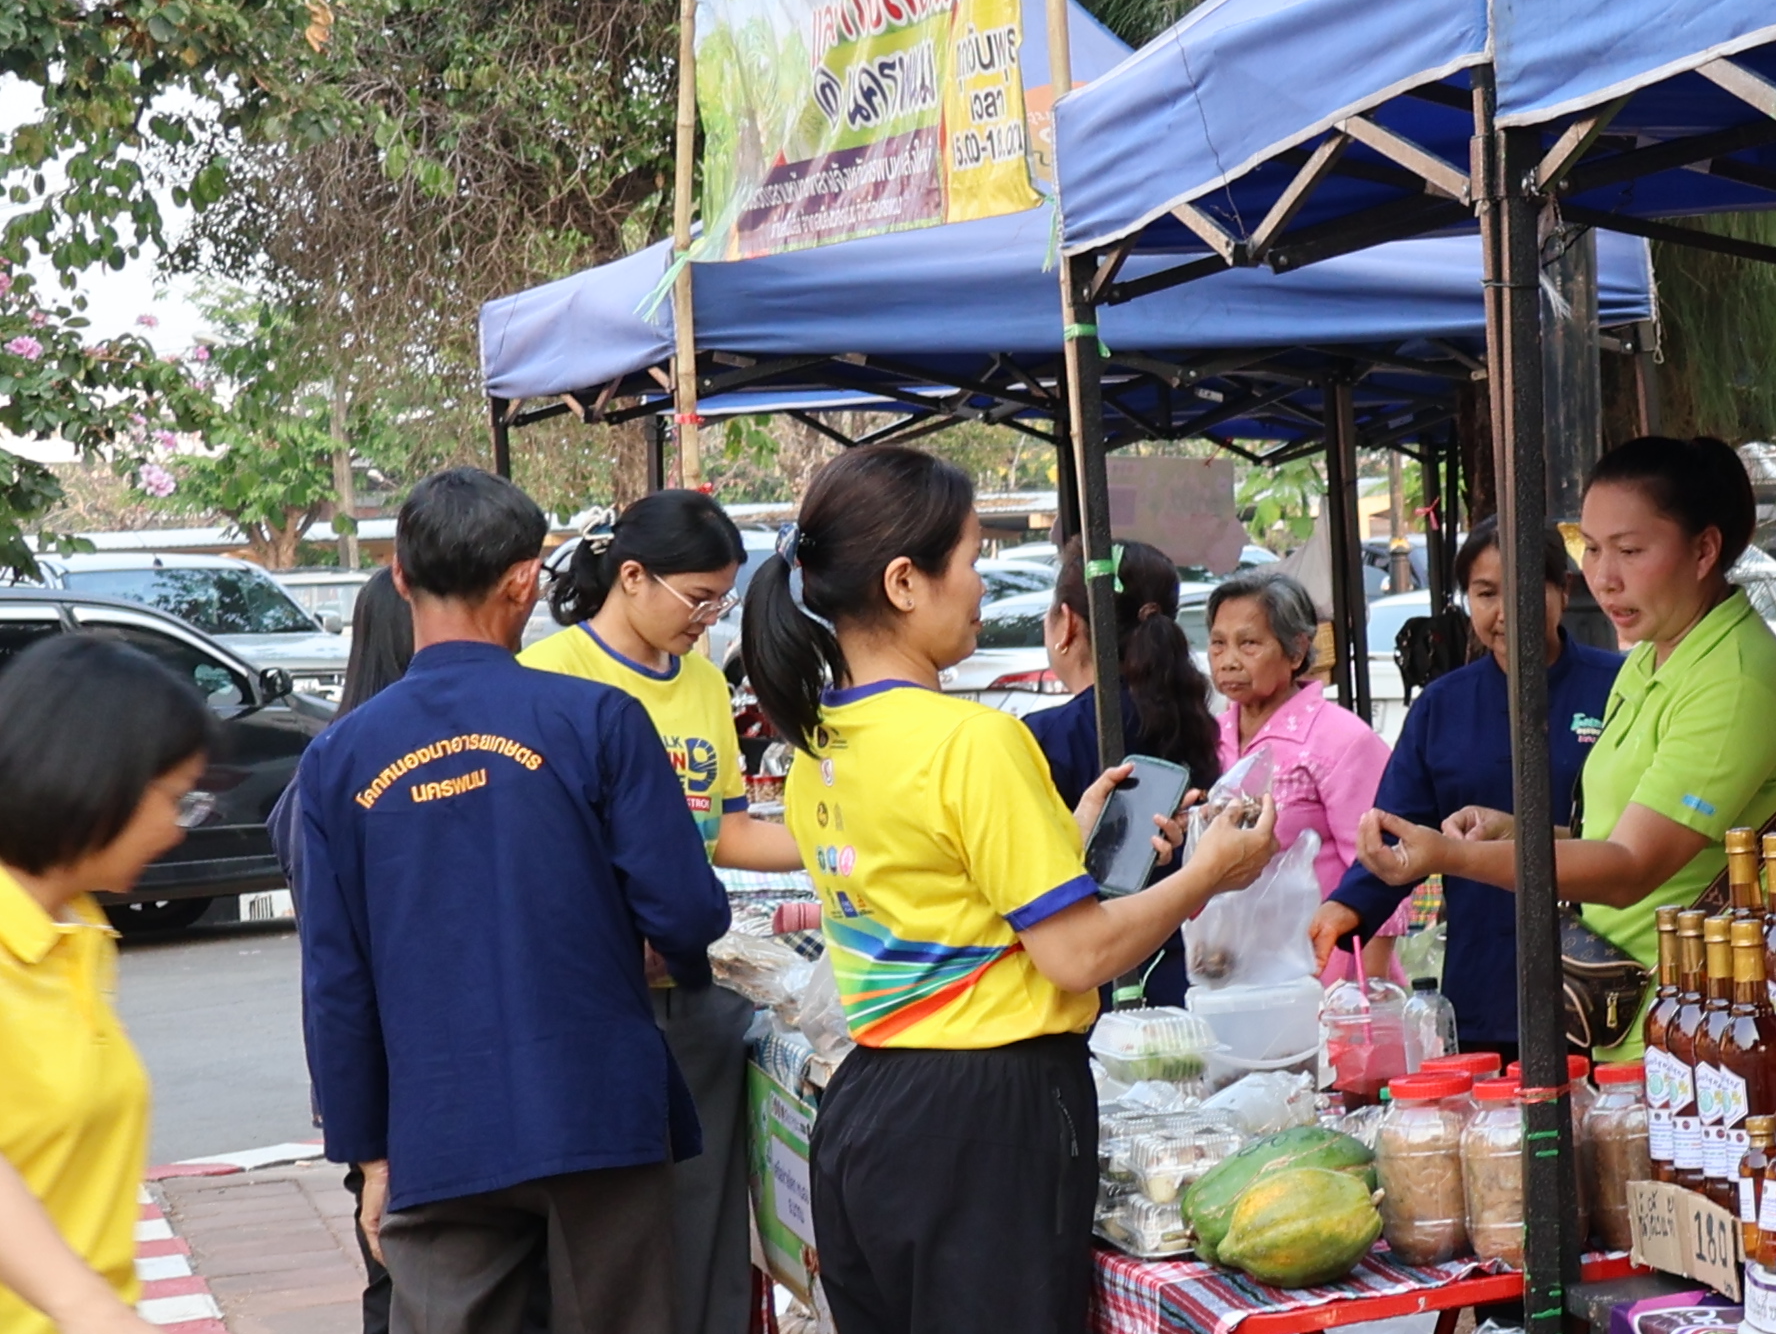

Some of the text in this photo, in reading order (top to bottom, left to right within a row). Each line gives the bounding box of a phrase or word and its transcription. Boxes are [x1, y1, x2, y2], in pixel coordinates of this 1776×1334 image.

[970, 89, 1005, 121] เวลา
[355, 733, 545, 809] โคกหนองนาอารยเกษตร
[410, 768, 488, 803] นครพนม
